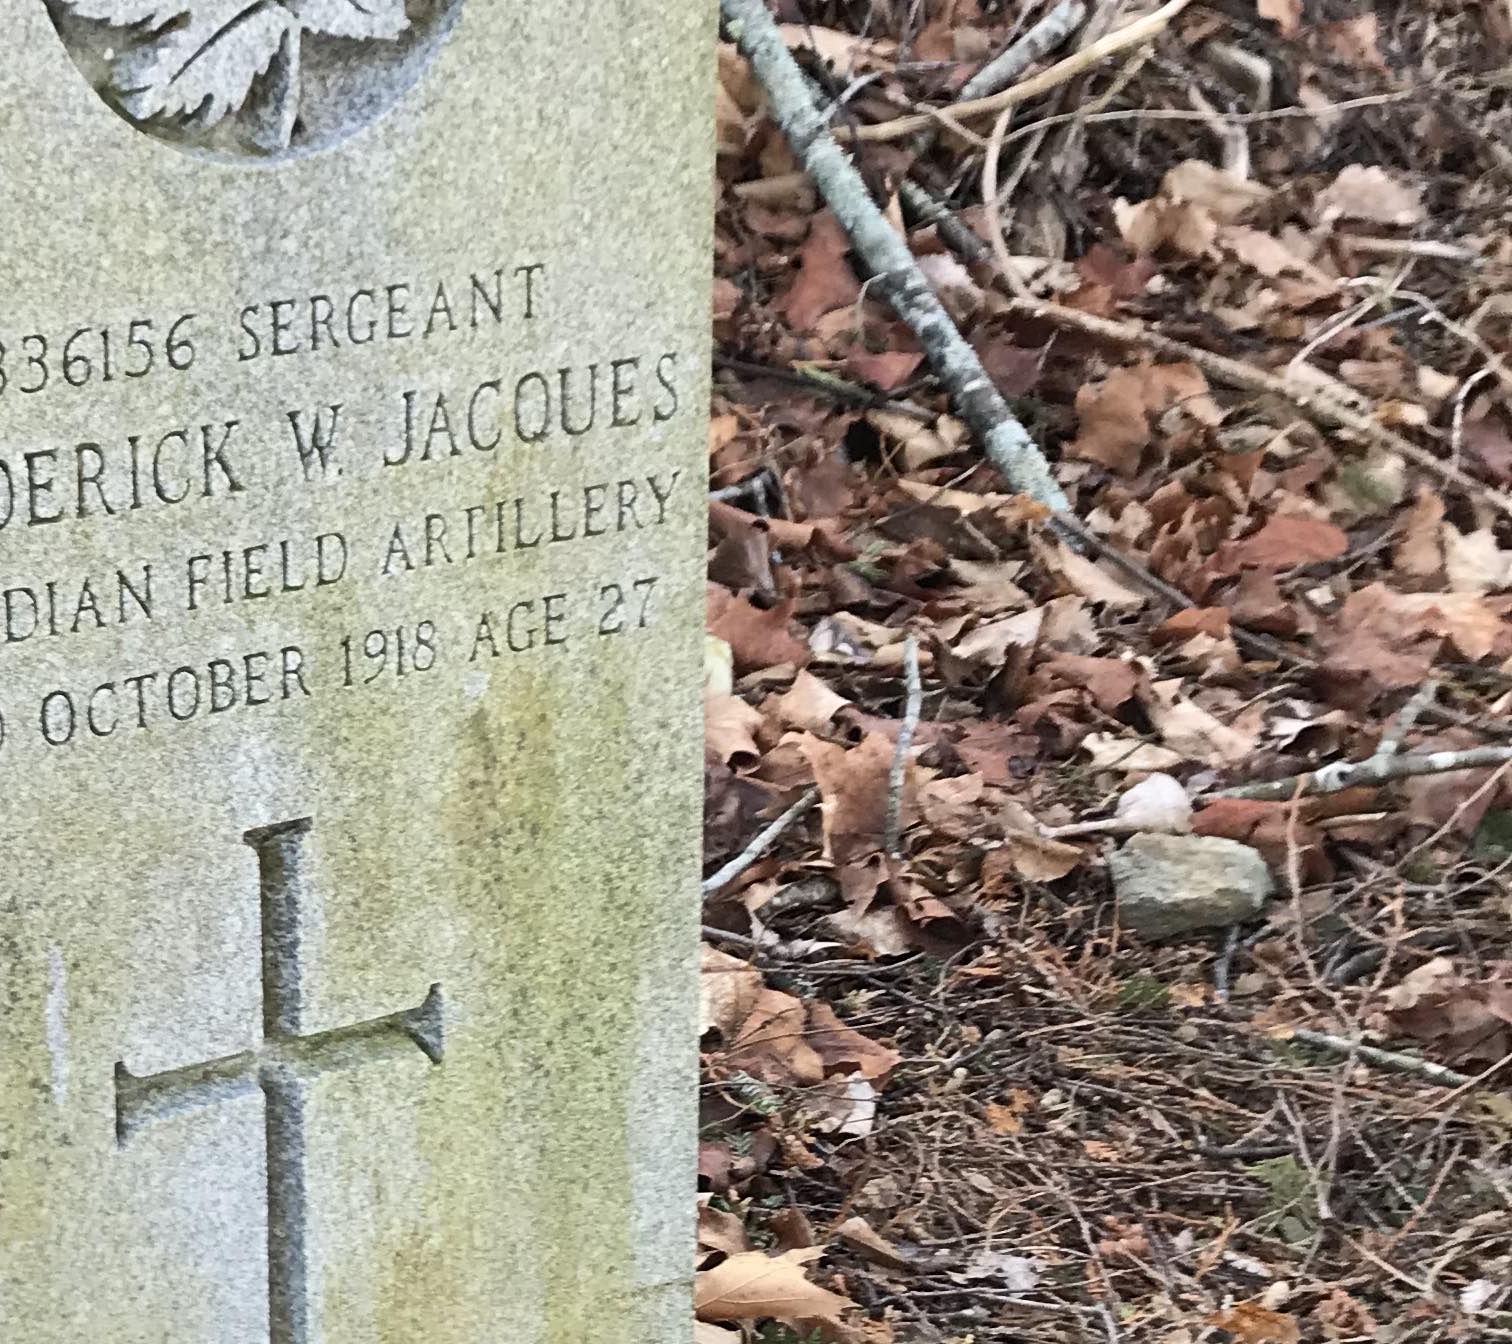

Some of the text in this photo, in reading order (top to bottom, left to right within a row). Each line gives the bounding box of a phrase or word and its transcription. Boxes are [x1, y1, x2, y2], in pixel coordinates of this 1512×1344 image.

[236, 262, 547, 362] SERGEANT
[288, 401, 345, 482] W.
[383, 350, 681, 470] JACQUES
[186, 530, 348, 611] FIELD
[381, 470, 682, 577] ARTILLERY
[40, 643, 312, 748] OCTOBER
[340, 618, 437, 688] 1918
[469, 591, 567, 664] AGE
[598, 576, 660, 638] 27
